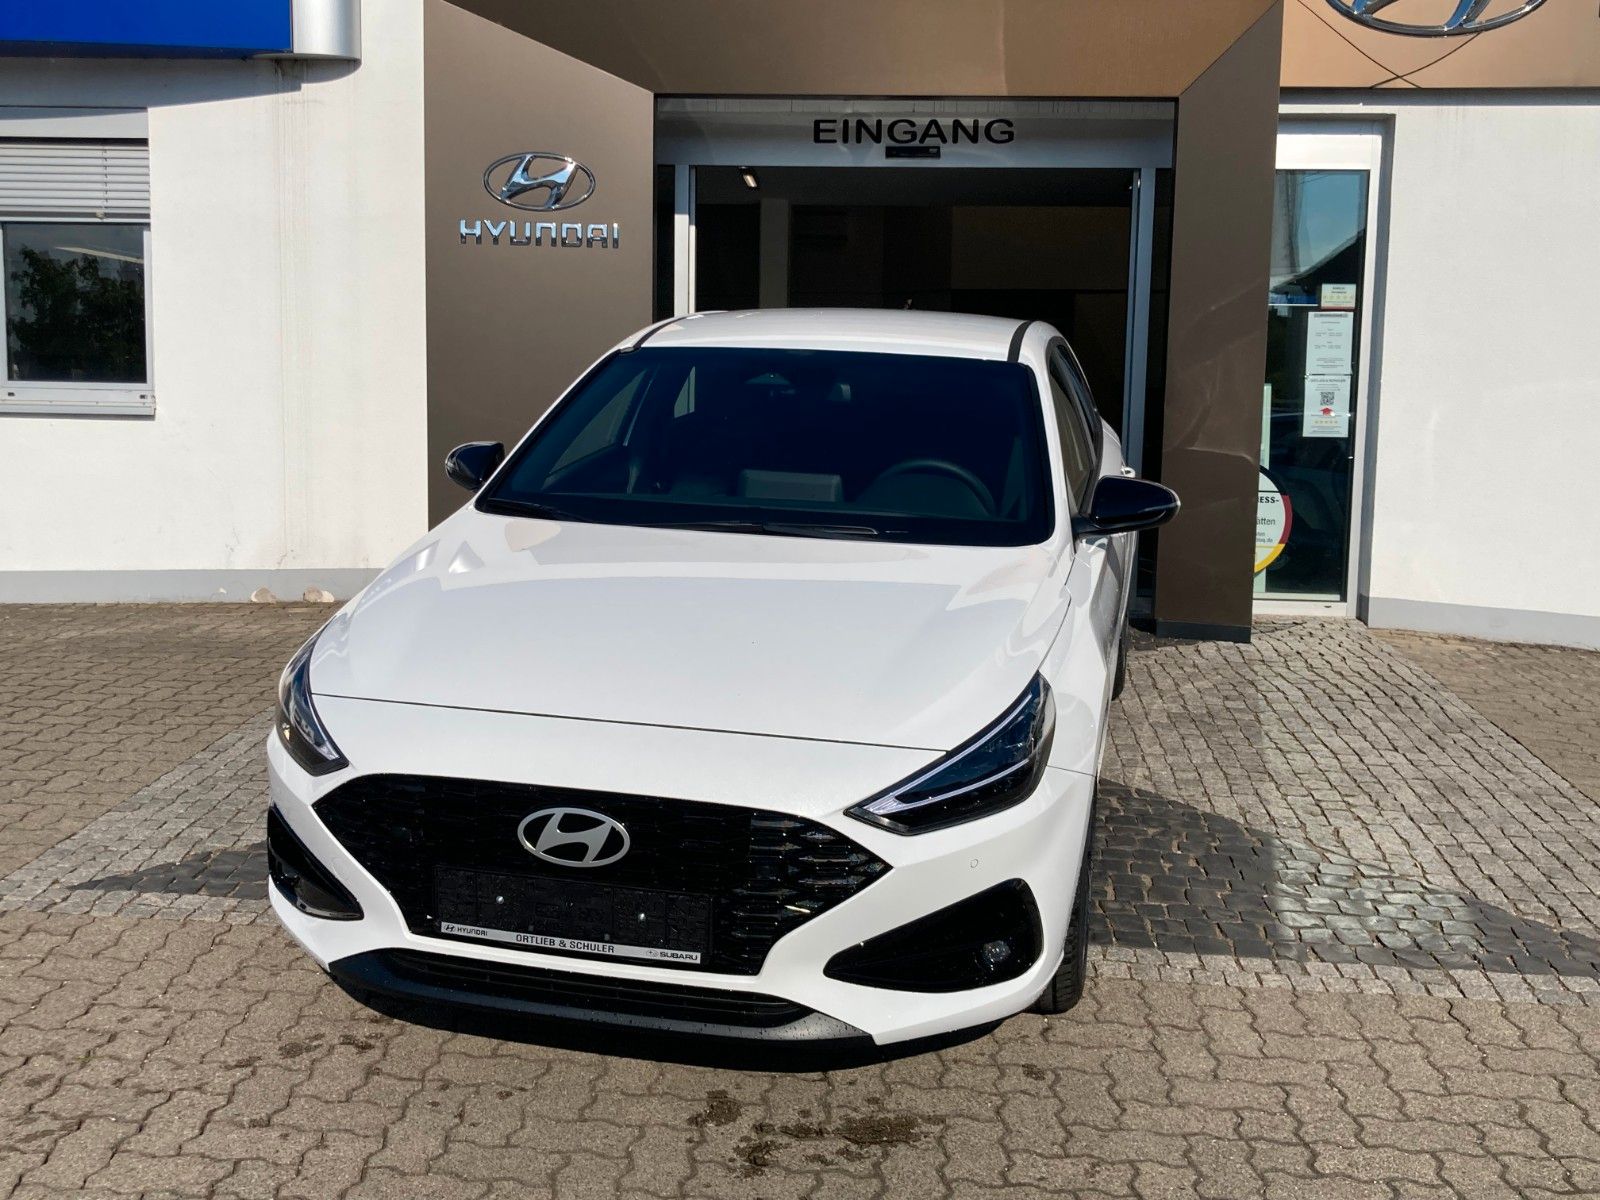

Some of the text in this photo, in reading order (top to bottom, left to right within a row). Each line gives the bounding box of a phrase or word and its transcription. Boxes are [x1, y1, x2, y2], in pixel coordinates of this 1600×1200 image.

[813, 118, 1015, 144] EINGANG
[459, 219, 620, 249] HYUNDAI
[457, 927, 488, 937] HYUNDAI
[516, 934, 615, 953] ORTLIEB & SCHULER
[659, 951, 698, 961] SUBARU
